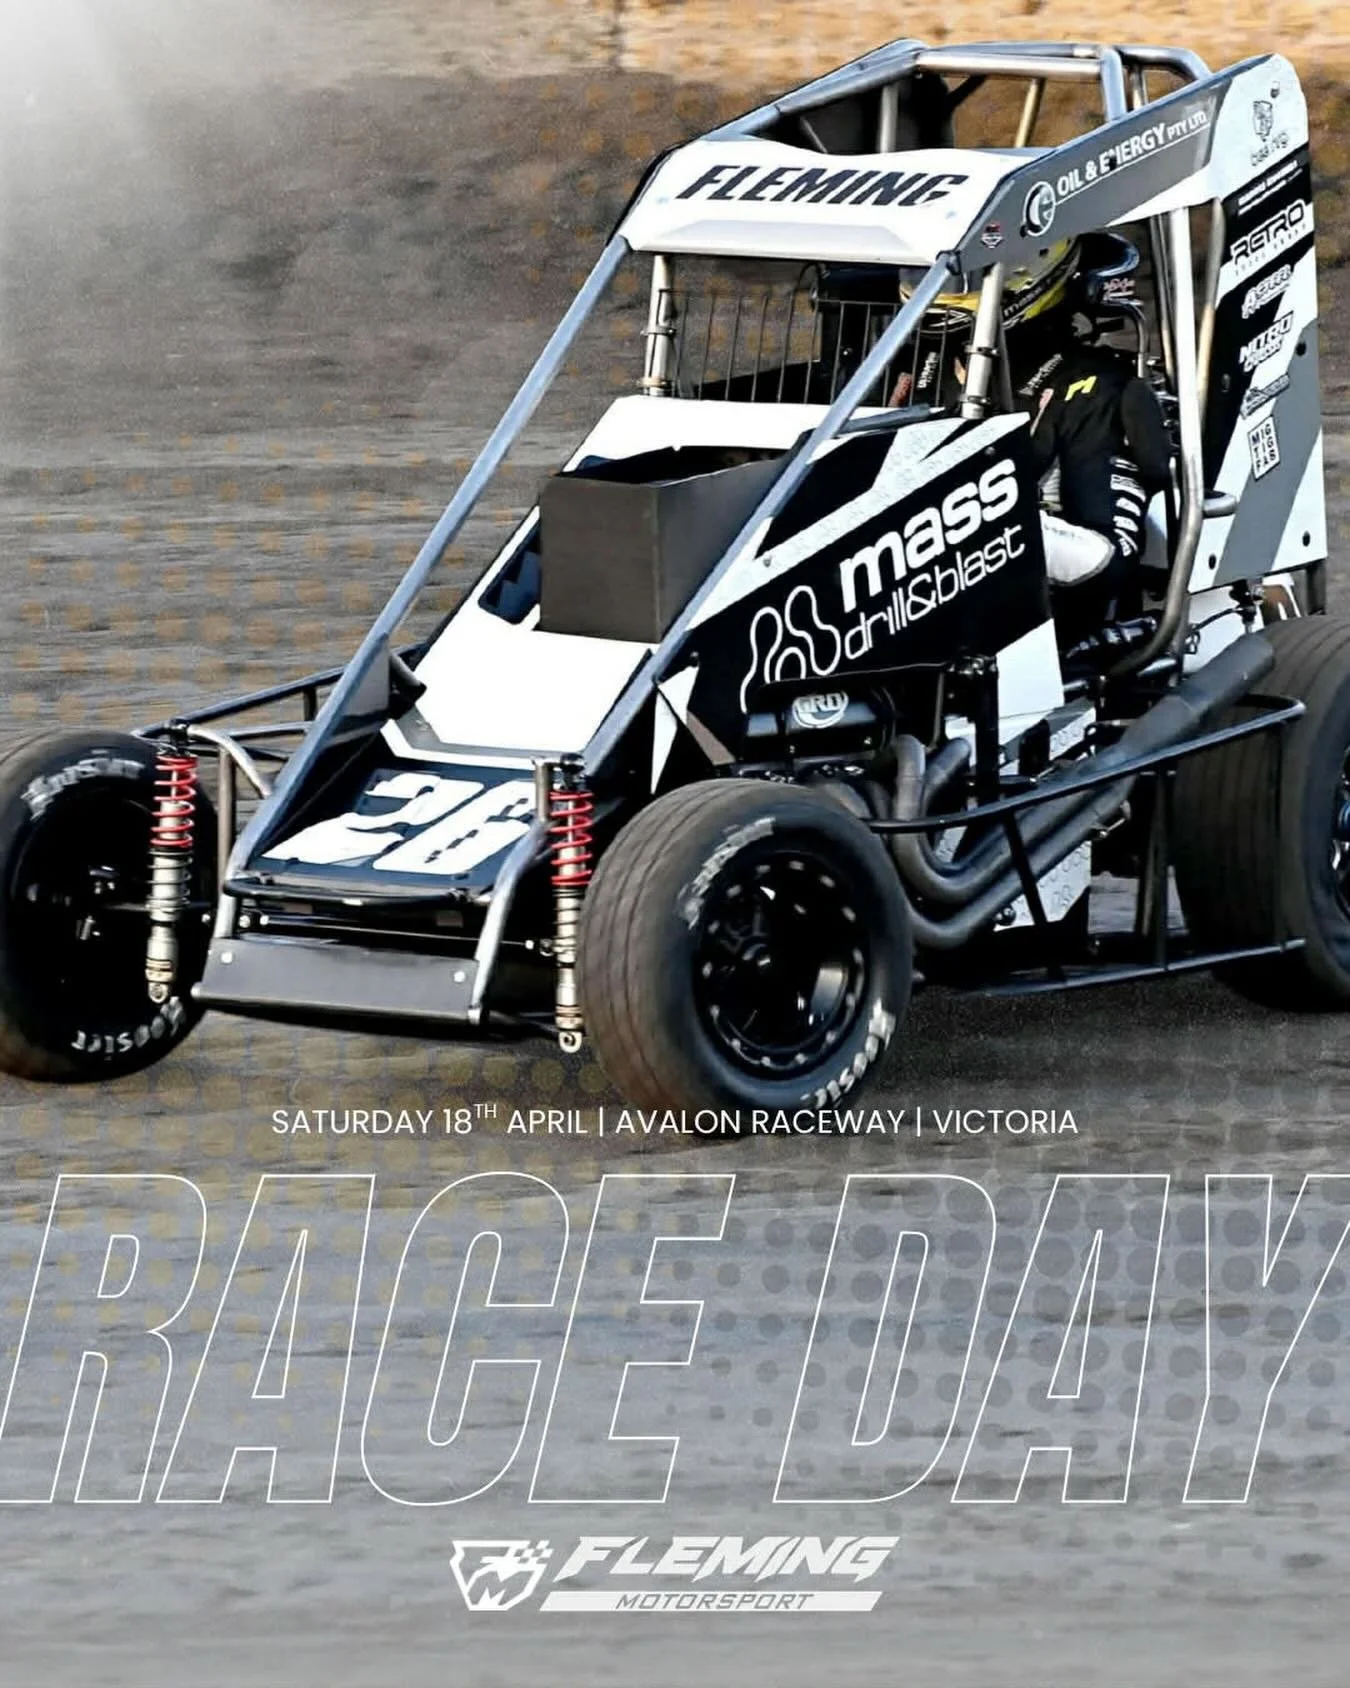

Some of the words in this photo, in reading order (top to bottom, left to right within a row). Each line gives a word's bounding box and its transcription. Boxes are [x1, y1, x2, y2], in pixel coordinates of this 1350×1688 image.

[675, 165, 970, 207] FLEMING
[1056, 169, 1086, 197] OIL
[1085, 161, 1098, 182] &
[1167, 121, 1189, 140] PTY
[1231, 200, 1305, 265] RETRO
[1239, 313, 1294, 364] NITRO
[838, 458, 1020, 614] mass
[844, 524, 1026, 660] drill&blast
[261, 772, 537, 875] 26
